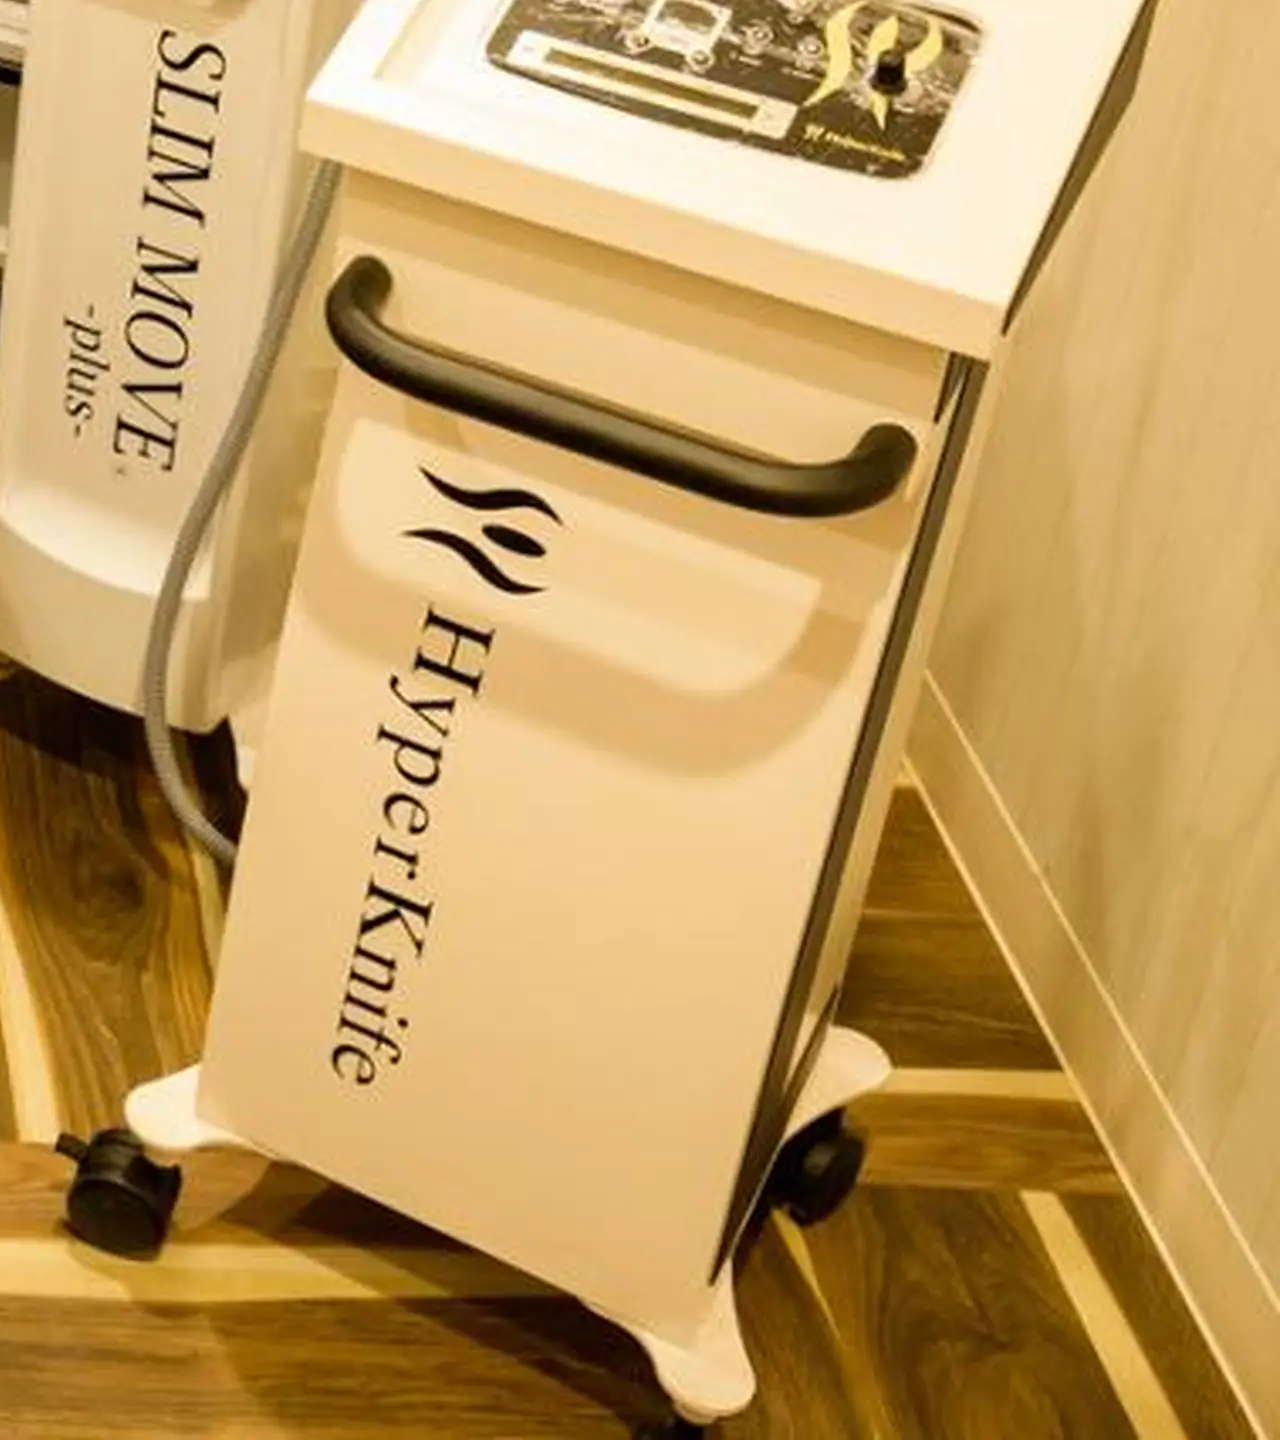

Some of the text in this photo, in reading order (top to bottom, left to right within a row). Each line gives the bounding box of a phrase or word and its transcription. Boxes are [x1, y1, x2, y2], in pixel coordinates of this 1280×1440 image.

[112, 28, 228, 473] SLIM MOVE
[331, 603, 497, 1088] HyperKnife
